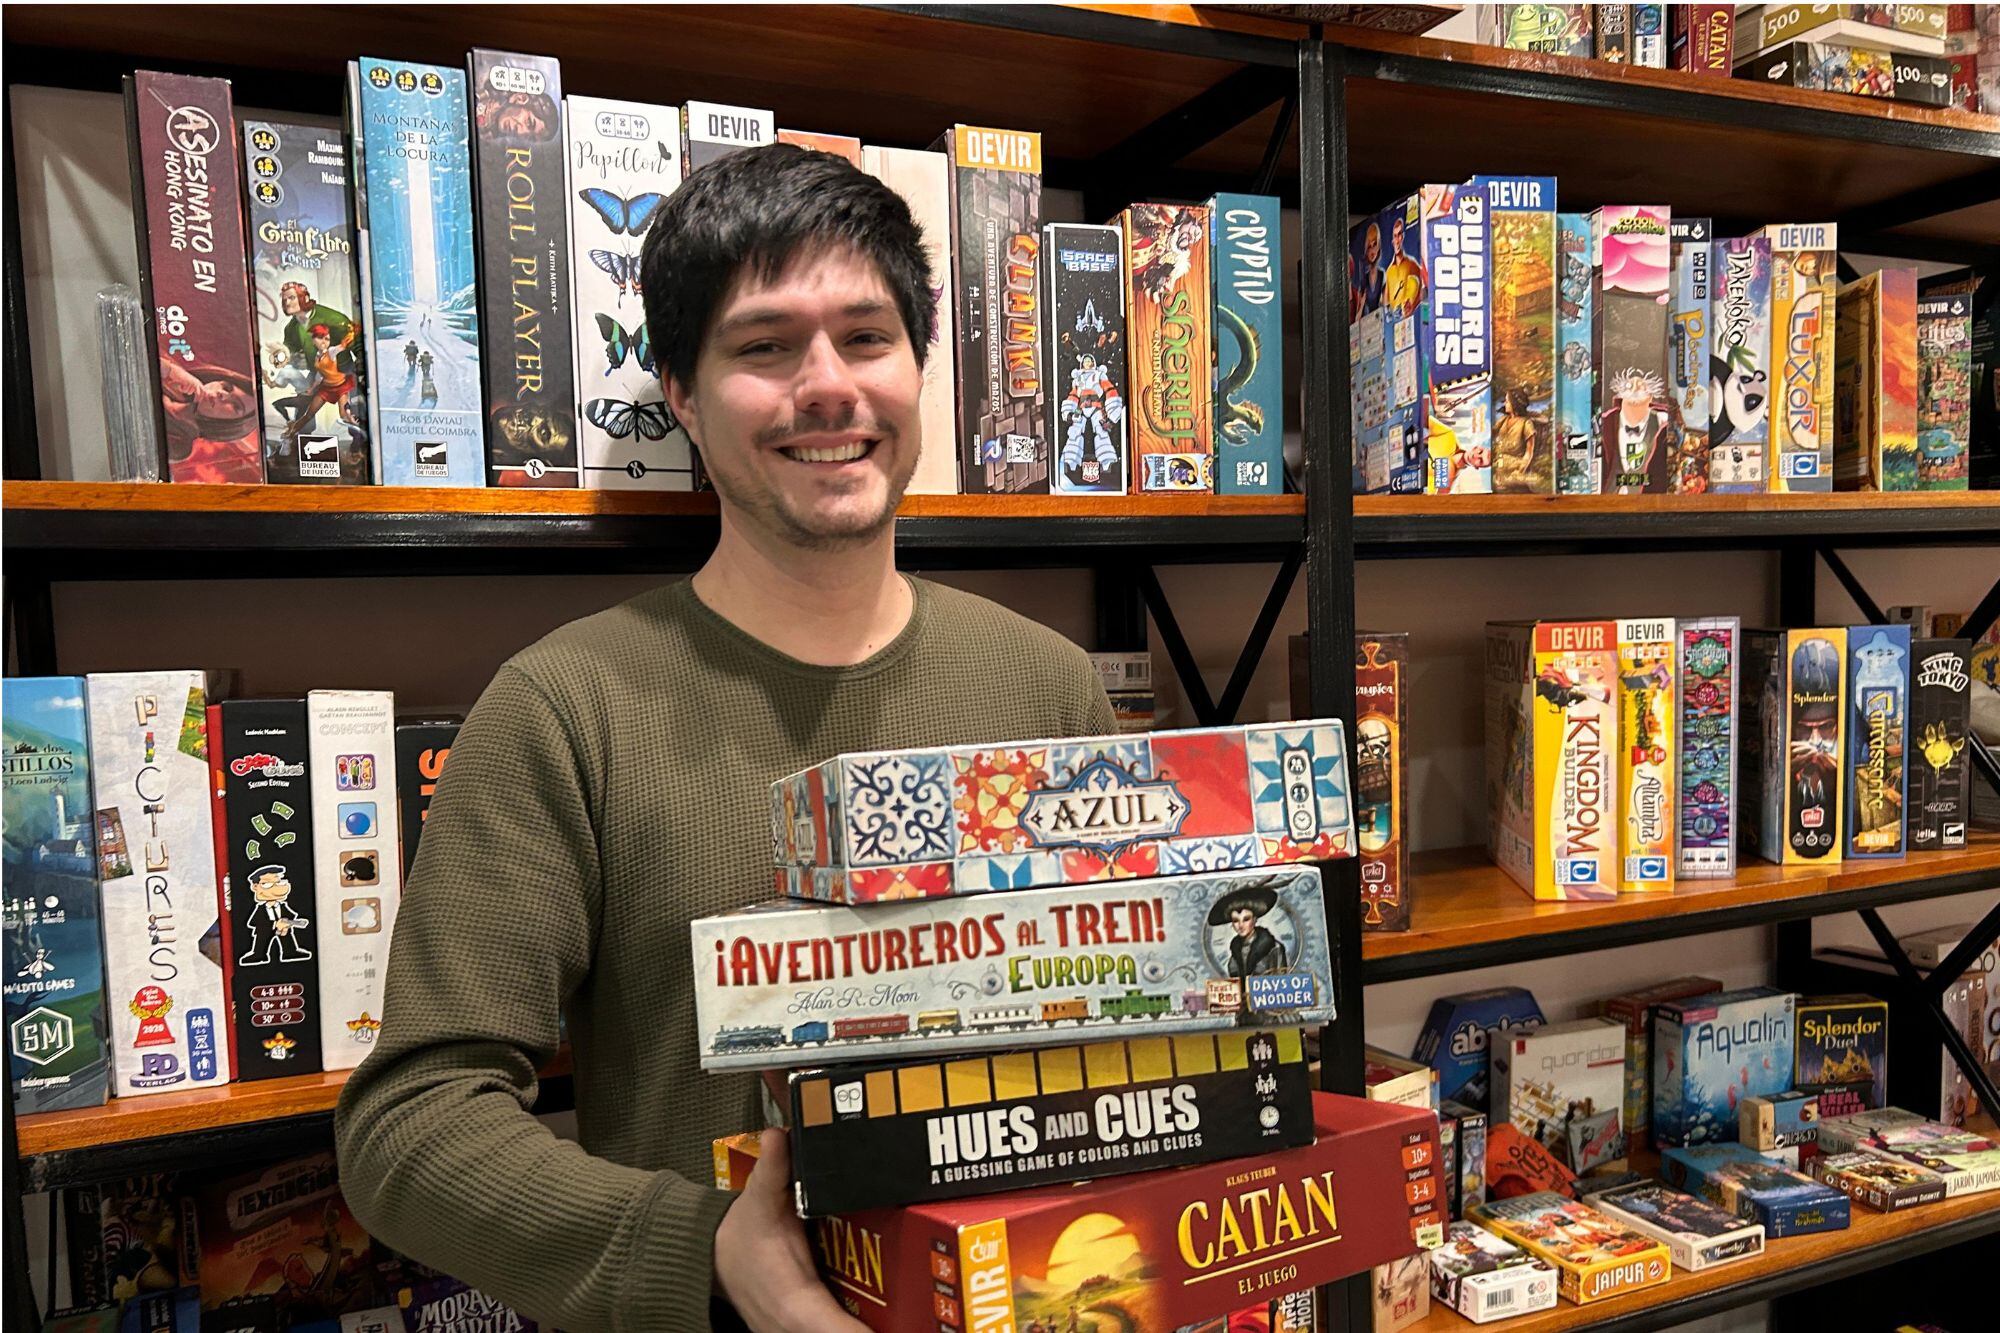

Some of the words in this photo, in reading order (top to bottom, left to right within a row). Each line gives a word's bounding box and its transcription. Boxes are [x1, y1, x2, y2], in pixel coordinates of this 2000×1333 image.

[1767, 9, 1799, 39] 500
[1900, 6, 1924, 24] 500
[1708, 10, 1729, 70] CATAN
[1895, 66, 1921, 83] 100
[373, 112, 458, 133] MONTAÑAS
[708, 113, 761, 142] DEVIR
[396, 131, 415, 144] DE
[420, 134, 438, 146] LA
[966, 130, 1032, 168] DEVIR
[387, 145, 449, 163] LOCURA
[573, 140, 668, 179] Papillon
[164, 150, 183, 199] HONG
[174, 109, 213, 253] ASESINATO
[505, 146, 538, 242] ROLL
[1488, 181, 1541, 207] DEVIR
[168, 201, 187, 251] KONG
[987, 221, 995, 239] UNA
[1619, 216, 1656, 226] POTION
[1670, 224, 1689, 236] VIR
[259, 221, 303, 245] Gran
[305, 226, 350, 259] Libro
[1780, 227, 1825, 248] DEVIR
[988, 242, 997, 287] AVENTURA
[1062, 250, 1116, 263] SPACE
[1066, 262, 1111, 272] BASE
[1225, 209, 1275, 304] CRYPTID
[192, 259, 217, 293] EN
[1457, 196, 1484, 365] QUADRO
[989, 288, 997, 300] DE
[1726, 246, 1755, 348] TAKENOKO
[156, 306, 167, 335] games
[167, 304, 189, 336] do
[1917, 302, 1948, 315] DEVIR
[511, 254, 545, 401] PLAYER
[989, 303, 999, 365] CONSTRUCCIÓN
[991, 367, 999, 379] DE
[1790, 311, 1816, 433] LUXOR
[992, 381, 1001, 412] MAZOS
[387, 425, 427, 435] MIGUEL
[429, 427, 477, 437] COIMBRA
[400, 415, 421, 424] ROB
[424, 416, 463, 425] DAVIAU
[301, 462, 335, 470] BUREAU
[1551, 627, 1604, 650] DEVIR
[1626, 624, 1665, 640] DEVIR
[1923, 656, 1962, 674] KING
[1356, 682, 1393, 697] amaica
[1918, 671, 1968, 692] TOKYO
[1793, 692, 1837, 708] Splendor
[319, 720, 389, 736] CONCEPT
[43, 743, 64, 753] dos
[34, 775, 68, 787] Ludwig
[1563, 747, 1575, 820] BUILDER
[1566, 713, 1601, 855] KINGDOM
[1051, 791, 1159, 833] AZUL
[1632, 769, 1665, 845] Alhambra
[135, 694, 178, 981] PICTURES
[714, 912, 1006, 987] ¡AVENTUREROS
[1017, 919, 1045, 947] AL
[1048, 897, 1166, 948] TREN!
[46, 979, 76, 992] GAMES
[1008, 953, 1137, 993] EUROPA
[1252, 978, 1288, 991] DAYS
[1291, 976, 1310, 989] OF
[261, 987, 275, 997] 4-8
[786, 986, 834, 1014] Alan
[837, 987, 866, 1009] R.
[868, 982, 921, 1007] Moon
[1218, 991, 1238, 1002] RIDE
[1253, 991, 1313, 1007] WONDER
[261, 1001, 275, 1010] 10+
[23, 1019, 63, 1052] SM
[1697, 1012, 1786, 1065] Aqualin
[1803, 1014, 1881, 1045] Splendor
[1825, 1033, 1858, 1050] Duel
[1541, 1044, 1621, 1073] quoridor
[139, 1076, 178, 1087] VERLAG
[926, 1106, 1039, 1166] HUES
[1045, 1112, 1090, 1142] AND
[1095, 1083, 1201, 1143] CUES
[931, 1170, 941, 1185] A
[942, 1158, 1014, 1183] GUESSING
[1017, 1155, 1057, 1174] GAME
[1058, 1150, 1075, 1166] OF
[1078, 1143, 1130, 1164] COLORS
[1133, 1138, 1161, 1157] AND
[1163, 1133, 1203, 1152] CLUES
[1411, 1148, 1427, 1165] 10+
[1226, 1174, 1250, 1187] KLAUS
[1250, 1166, 1277, 1182] TEUBER
[1953, 1172, 1975, 1192] JARDÍN
[1975, 1168, 2000, 1188] JAPONÉS
[1413, 1183, 1430, 1199] 3-4
[1177, 1171, 1339, 1270] CATAN
[1238, 1279, 1254, 1295] EL
[1257, 1265, 1298, 1290] JUEGO
[1590, 1261, 1644, 1297] JAIPUR
